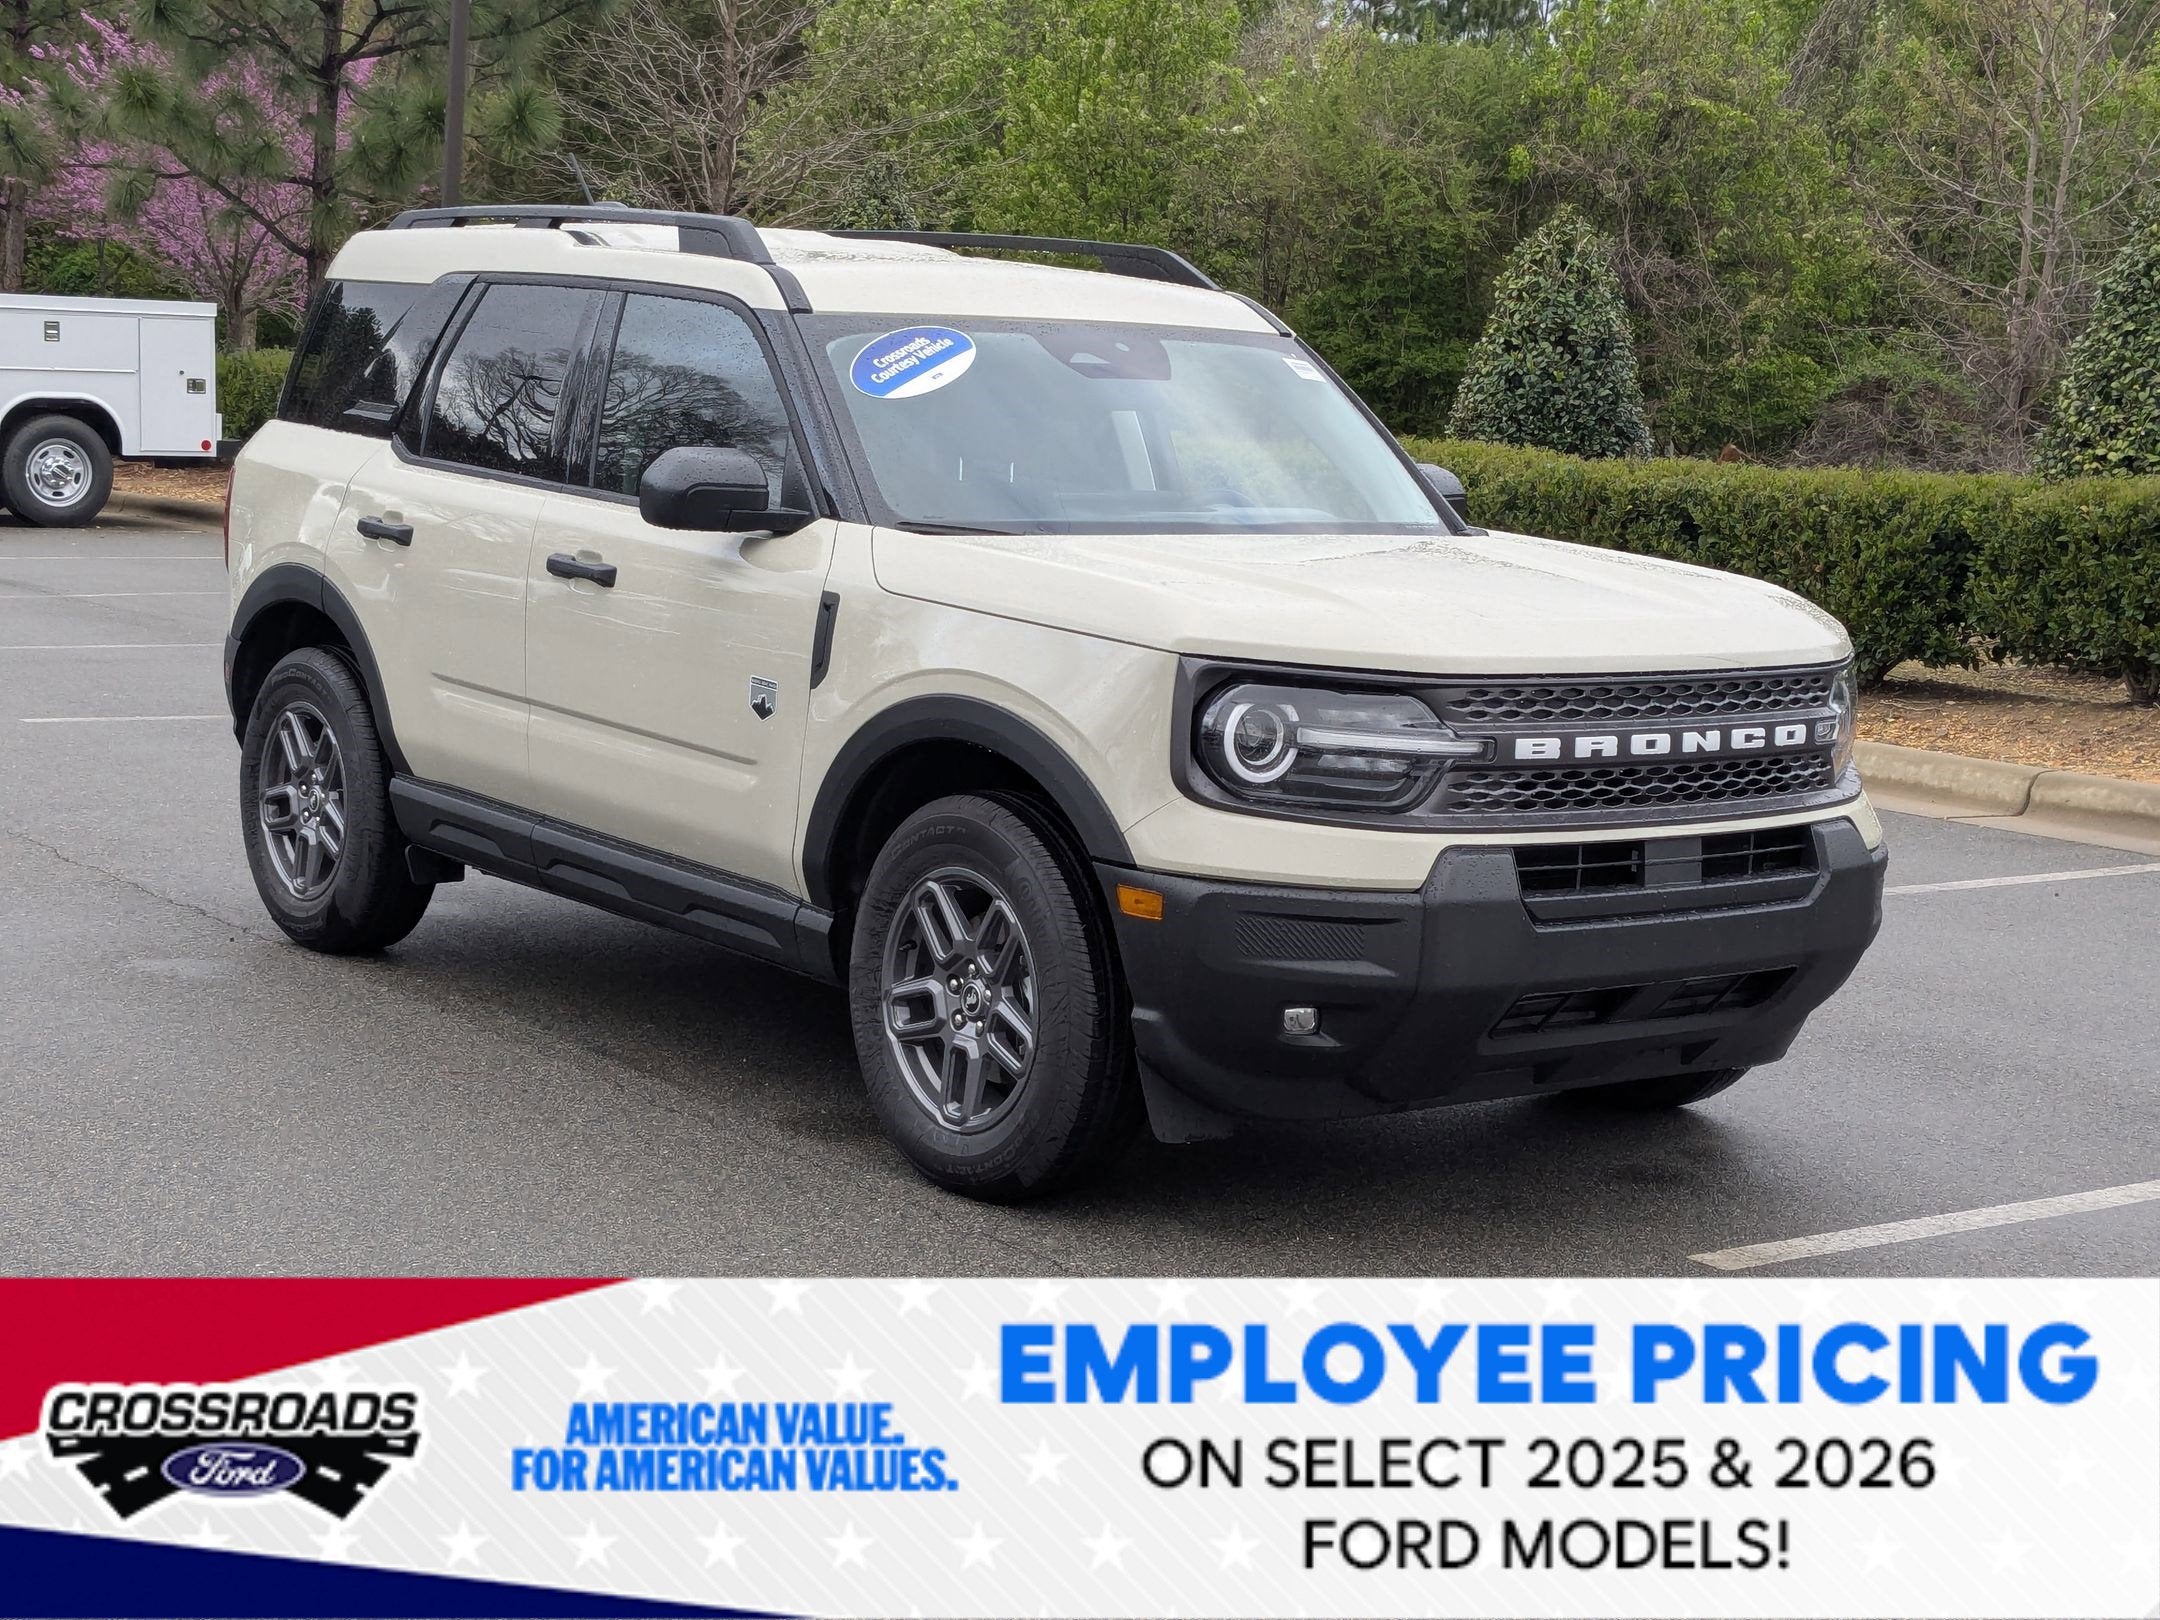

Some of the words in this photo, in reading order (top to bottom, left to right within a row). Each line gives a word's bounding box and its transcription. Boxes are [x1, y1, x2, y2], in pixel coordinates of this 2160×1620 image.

[872, 356, 920, 383] Courtesy
[918, 337, 954, 360] Vehicle
[873, 336, 932, 368] Crossroads
[1514, 724, 1807, 760] BRONCO
